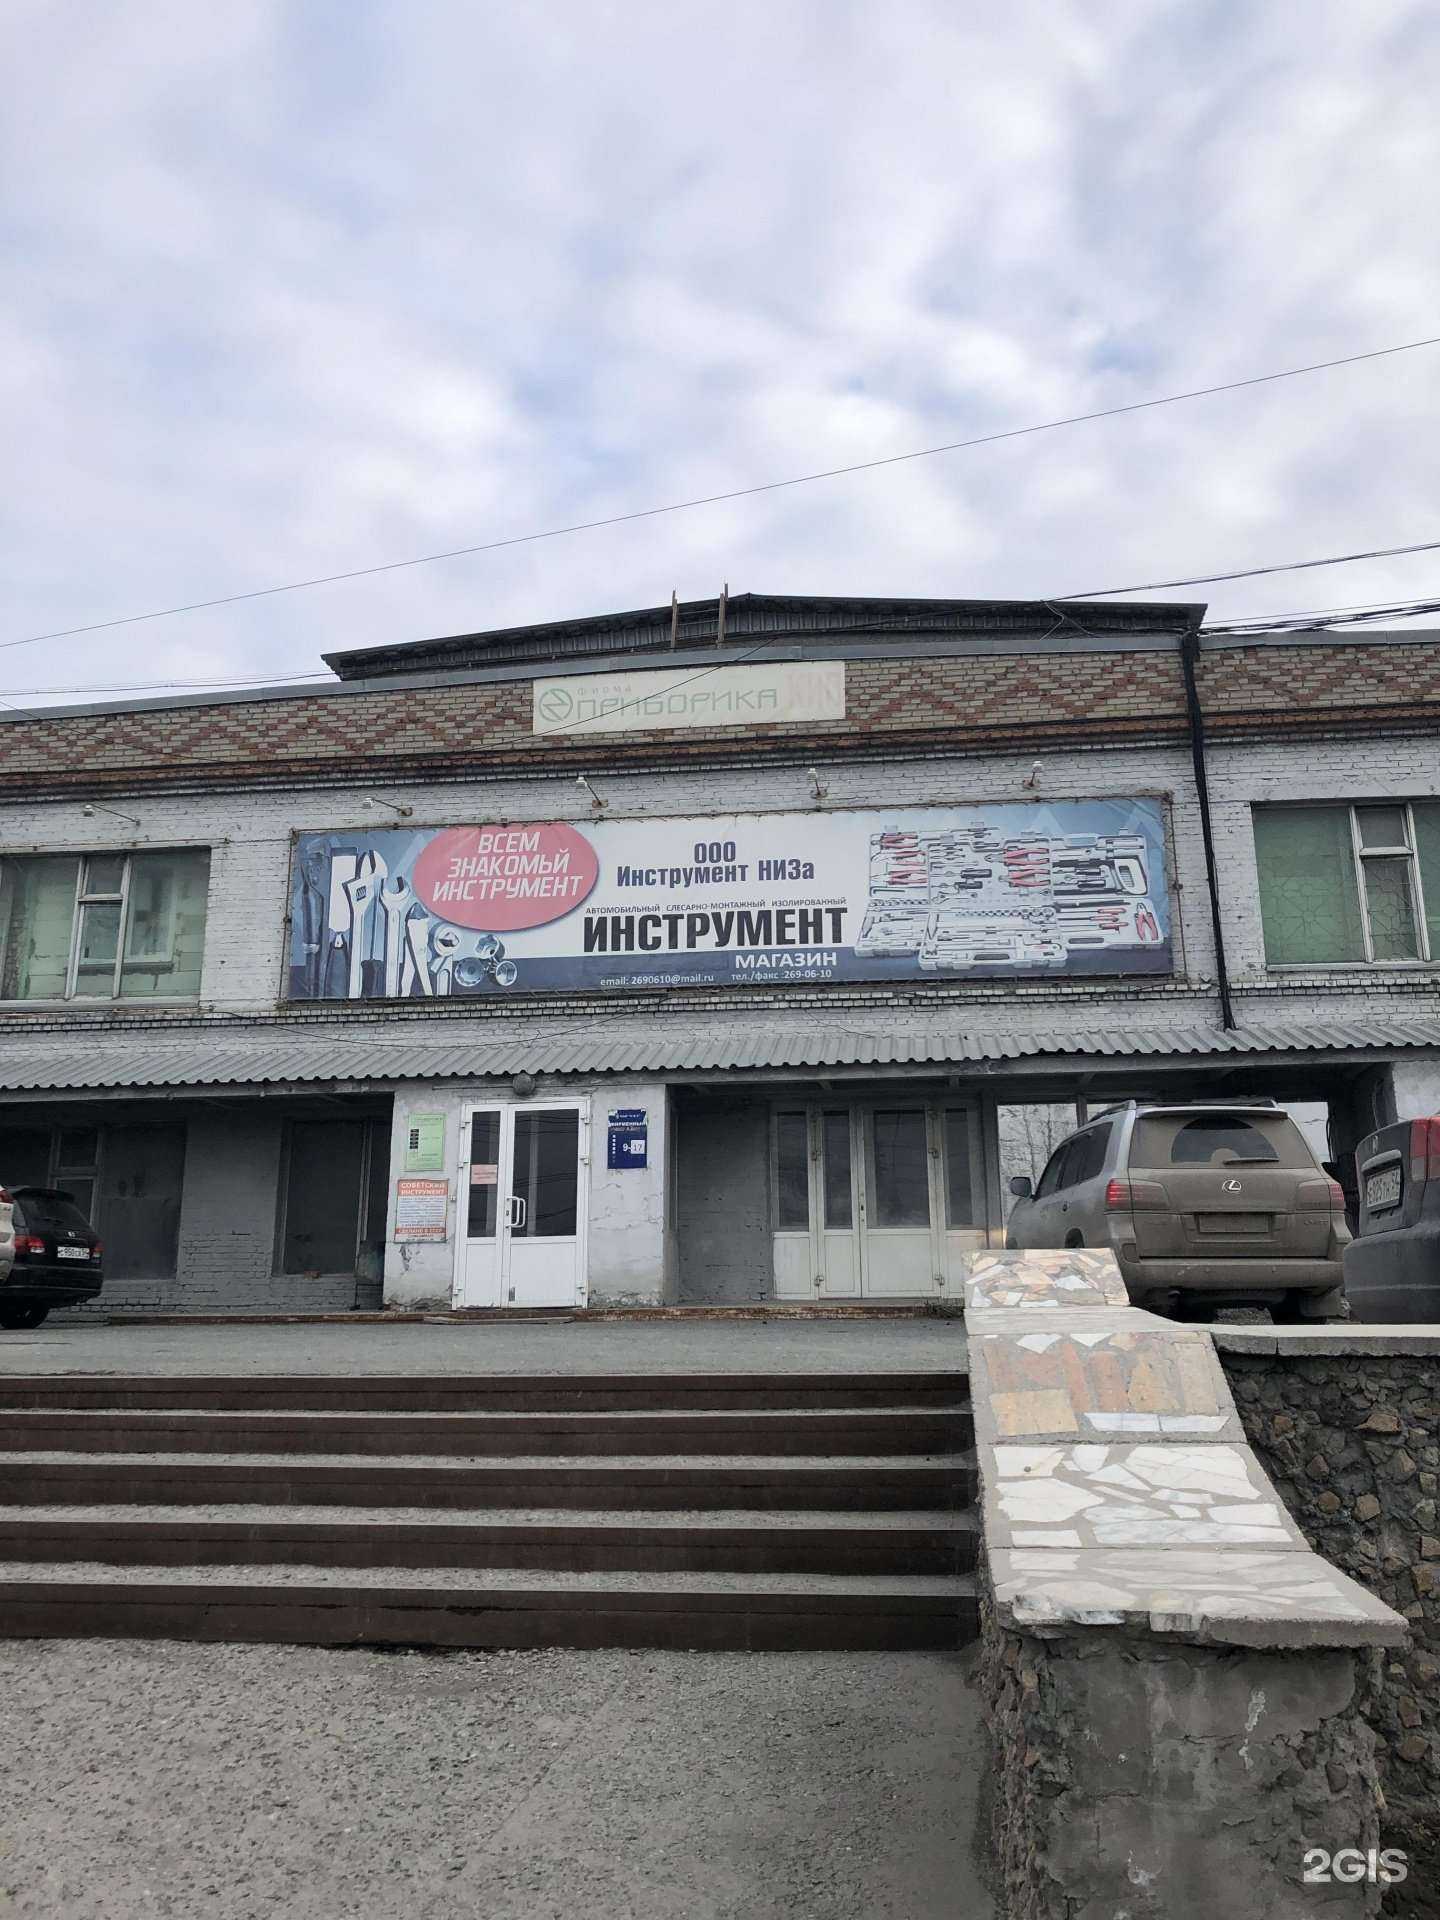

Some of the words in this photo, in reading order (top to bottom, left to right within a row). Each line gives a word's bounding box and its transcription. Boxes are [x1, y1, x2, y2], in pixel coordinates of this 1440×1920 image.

[478, 832, 541, 853] ВСЕМ
[694, 841, 736, 864] ООО
[617, 864, 748, 888] Инструмент
[759, 858, 814, 881] НИЗа
[432, 875, 583, 901] ИНСТРУМЕНТ
[585, 904, 660, 914] АВТОМОБИЛЬНЫЙ
[666, 899, 766, 911] СЛЕСАРНО-МОНТАЖНЫЙ
[772, 897, 847, 907] ИЗОЛИРОВАННЫЙ
[583, 907, 848, 953] ИНСТРУМЕНТ
[735, 951, 837, 969] МАГАЗИН
[600, 977, 629, 986] email:
[631, 974, 714, 985] 2690610@mail.ru
